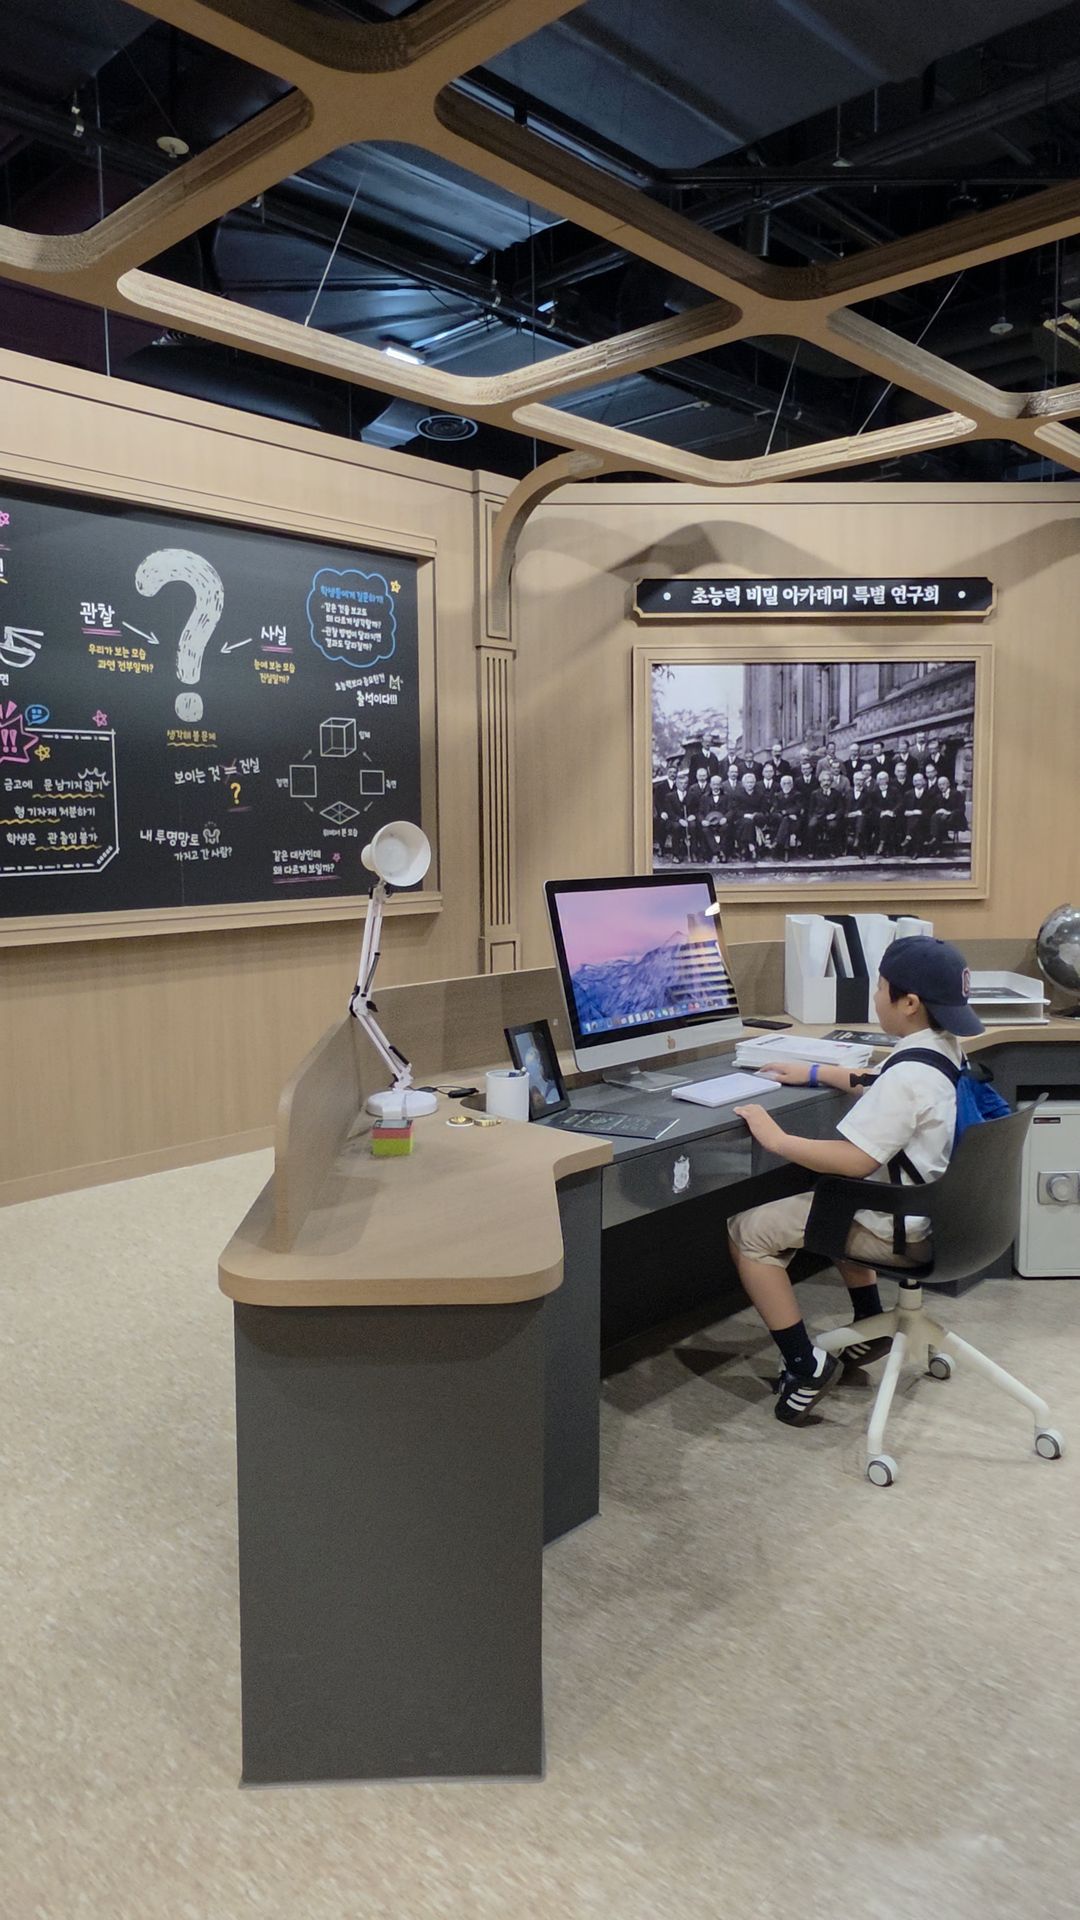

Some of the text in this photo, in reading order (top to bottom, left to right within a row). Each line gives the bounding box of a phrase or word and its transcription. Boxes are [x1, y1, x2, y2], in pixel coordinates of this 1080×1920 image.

[691, 585, 939, 606] 초능력 비밀 아카데미 특별 연구회
[80, 602, 115, 627] 관찰
[261, 625, 287, 646] 사실
[88, 643, 147, 661] 우리가 보는 모습
[97, 659, 154, 674] 과연 전부일까?
[282, 662, 296, 674] 모습
[174, 768, 206, 784] 보이는
[208, 765, 221, 782] 것
[239, 757, 260, 774] 진실
[4, 778, 103, 793] 금고에 문 남기지 않기
[14, 805, 96, 819] 형 기자재 처분하기
[6, 831, 98, 846] 학생은 관 출입 불가
[140, 829, 153, 842] 내
[174, 846, 233, 862] 가지고 간 사람?
[272, 849, 321, 862] 같은 대상인데
[273, 863, 335, 875] 왜 다르게 보일까?
